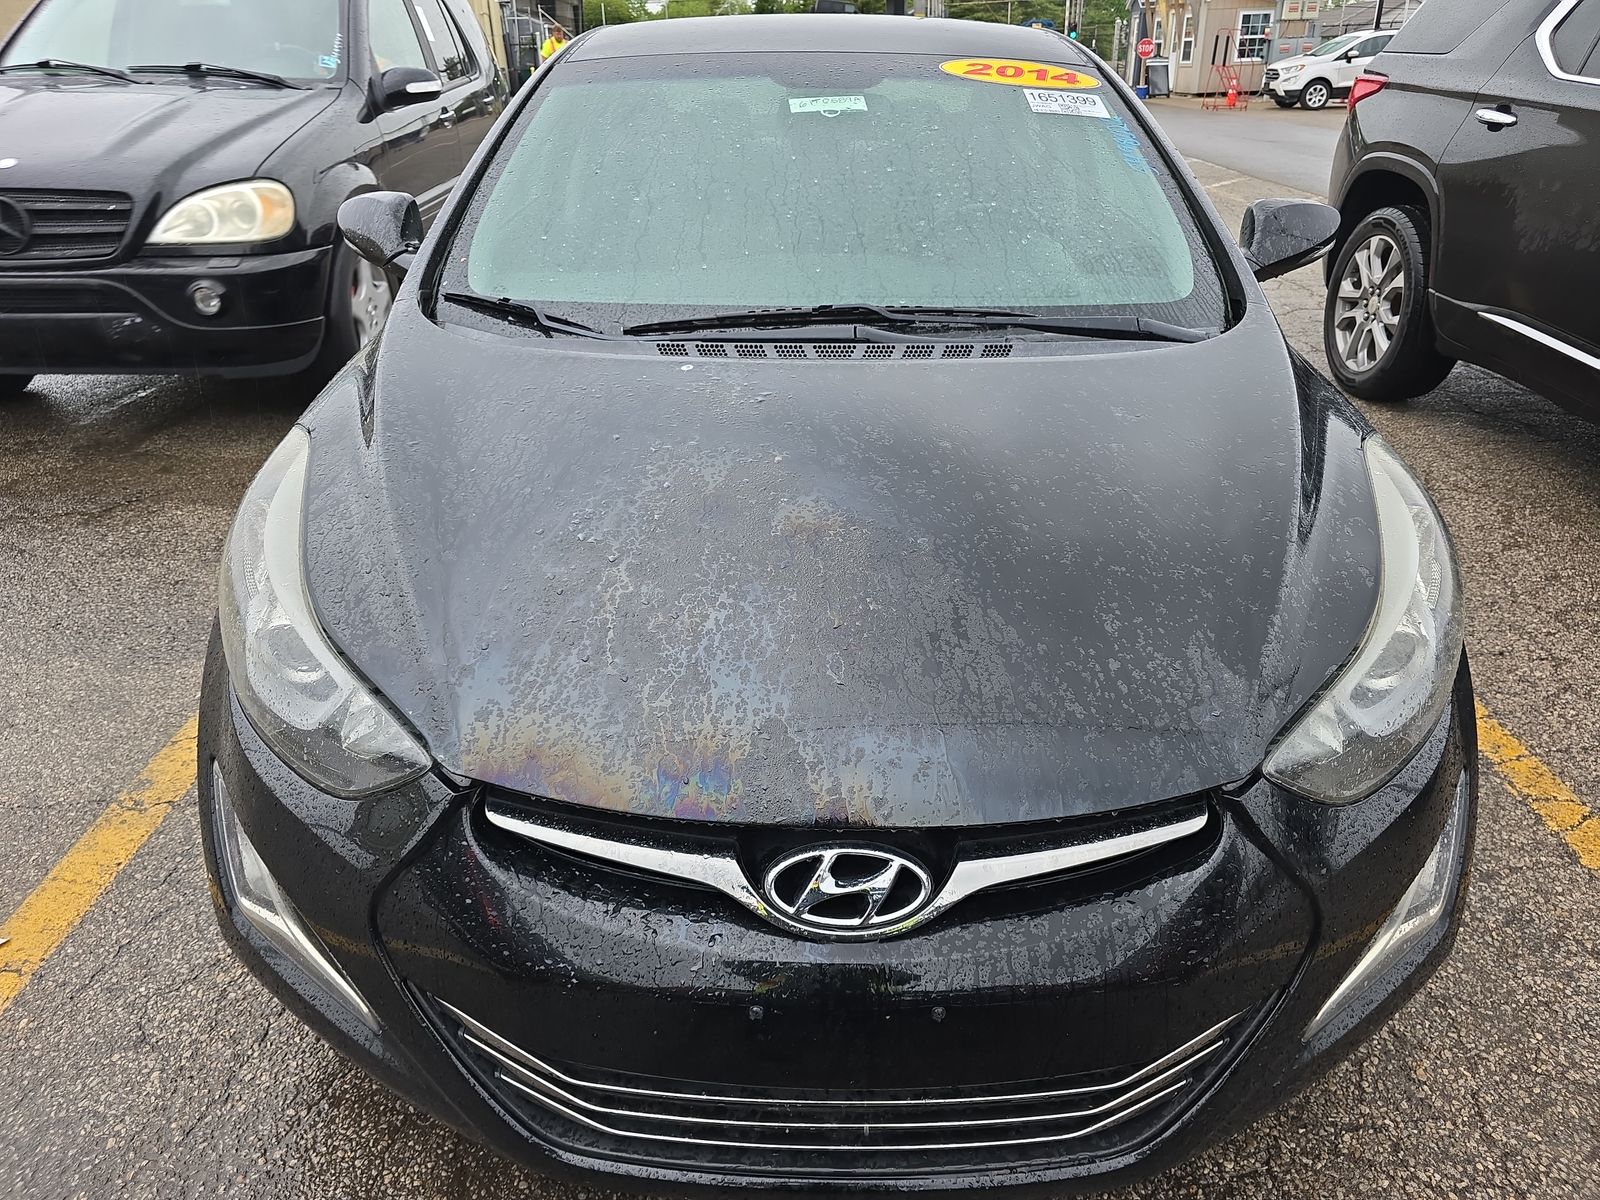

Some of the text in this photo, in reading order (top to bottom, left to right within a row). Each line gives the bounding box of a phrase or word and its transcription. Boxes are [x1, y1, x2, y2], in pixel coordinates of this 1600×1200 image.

[1138, 44, 1153, 53] STOP
[963, 63, 1080, 85] 2014
[1029, 92, 1096, 106] 1651399
